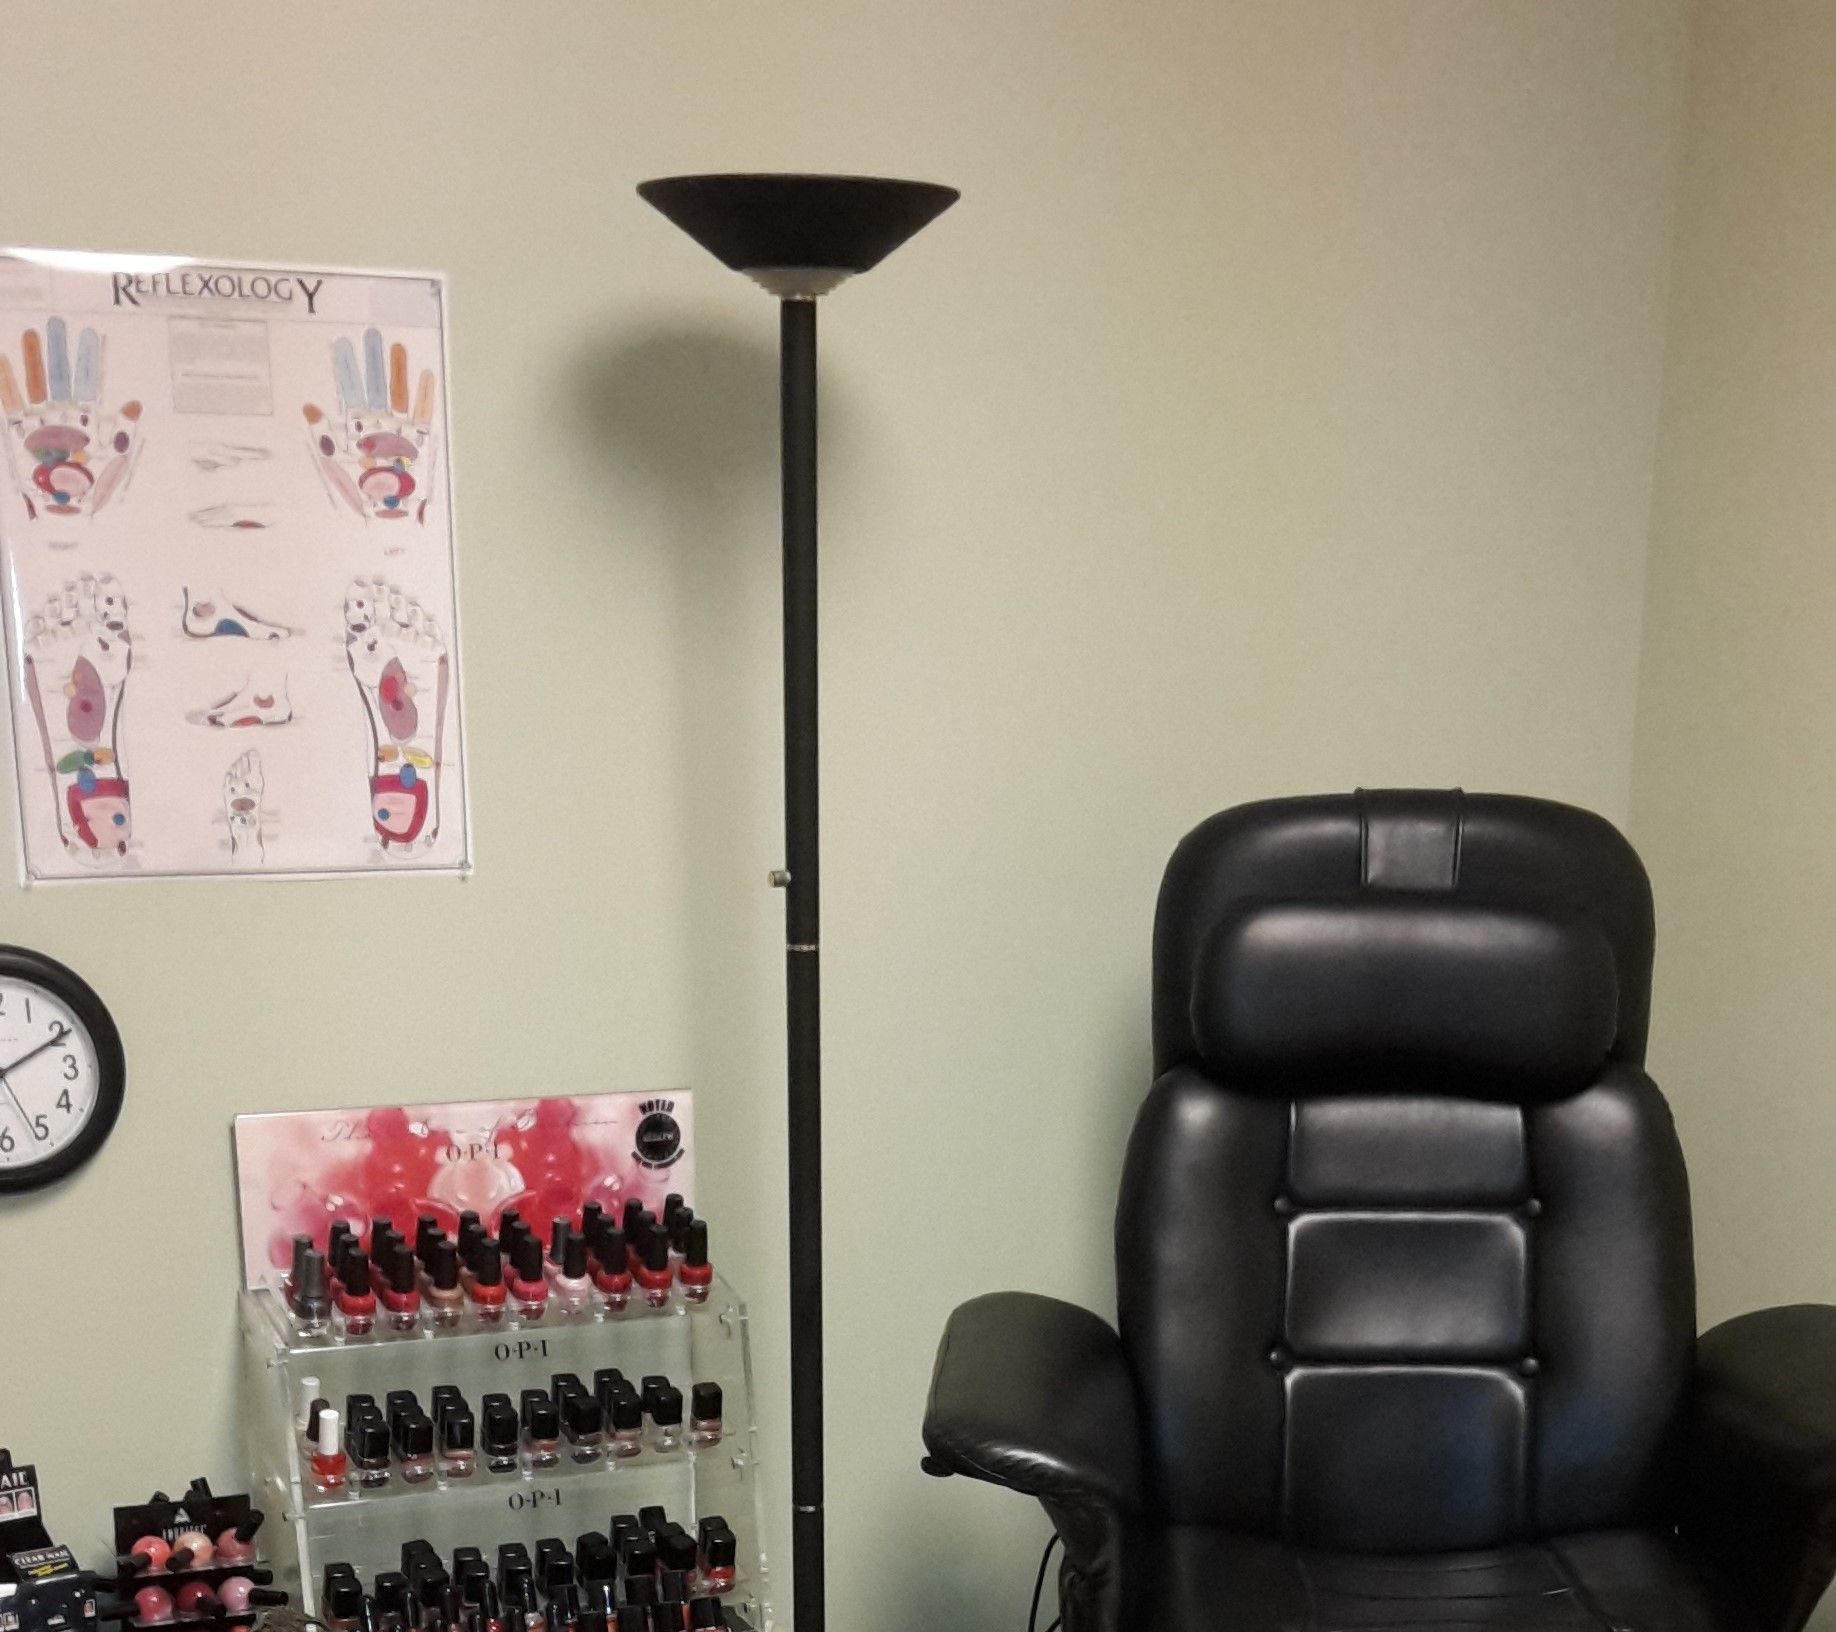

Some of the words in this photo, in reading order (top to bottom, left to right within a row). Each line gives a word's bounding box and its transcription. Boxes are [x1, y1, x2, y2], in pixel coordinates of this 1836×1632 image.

[113, 271, 322, 313] REFLEXOLOGY
[25, 998, 32, 1024] 1
[48, 1020, 66, 1047] 2
[62, 1054, 79, 1081] 3
[55, 1089, 73, 1114] 4
[0, 1126, 15, 1152] 6
[35, 1114, 49, 1141] 5
